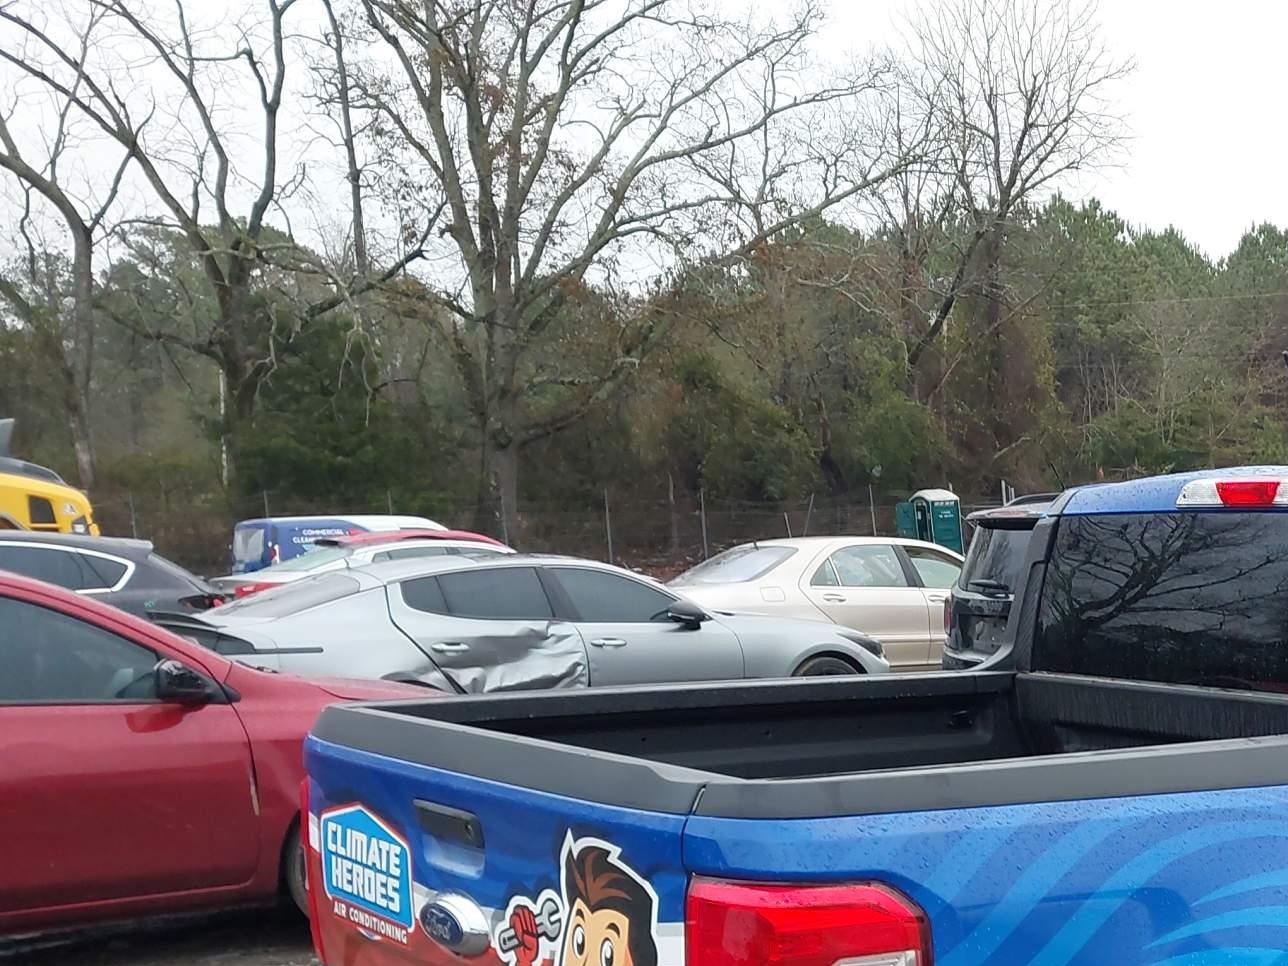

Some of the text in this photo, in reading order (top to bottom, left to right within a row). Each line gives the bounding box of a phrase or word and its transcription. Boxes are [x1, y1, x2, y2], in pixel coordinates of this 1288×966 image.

[327, 821, 402, 877] CLIMATE
[331, 855, 400, 913] HEROES
[334, 901, 407, 944] AIR CONDITIONING
